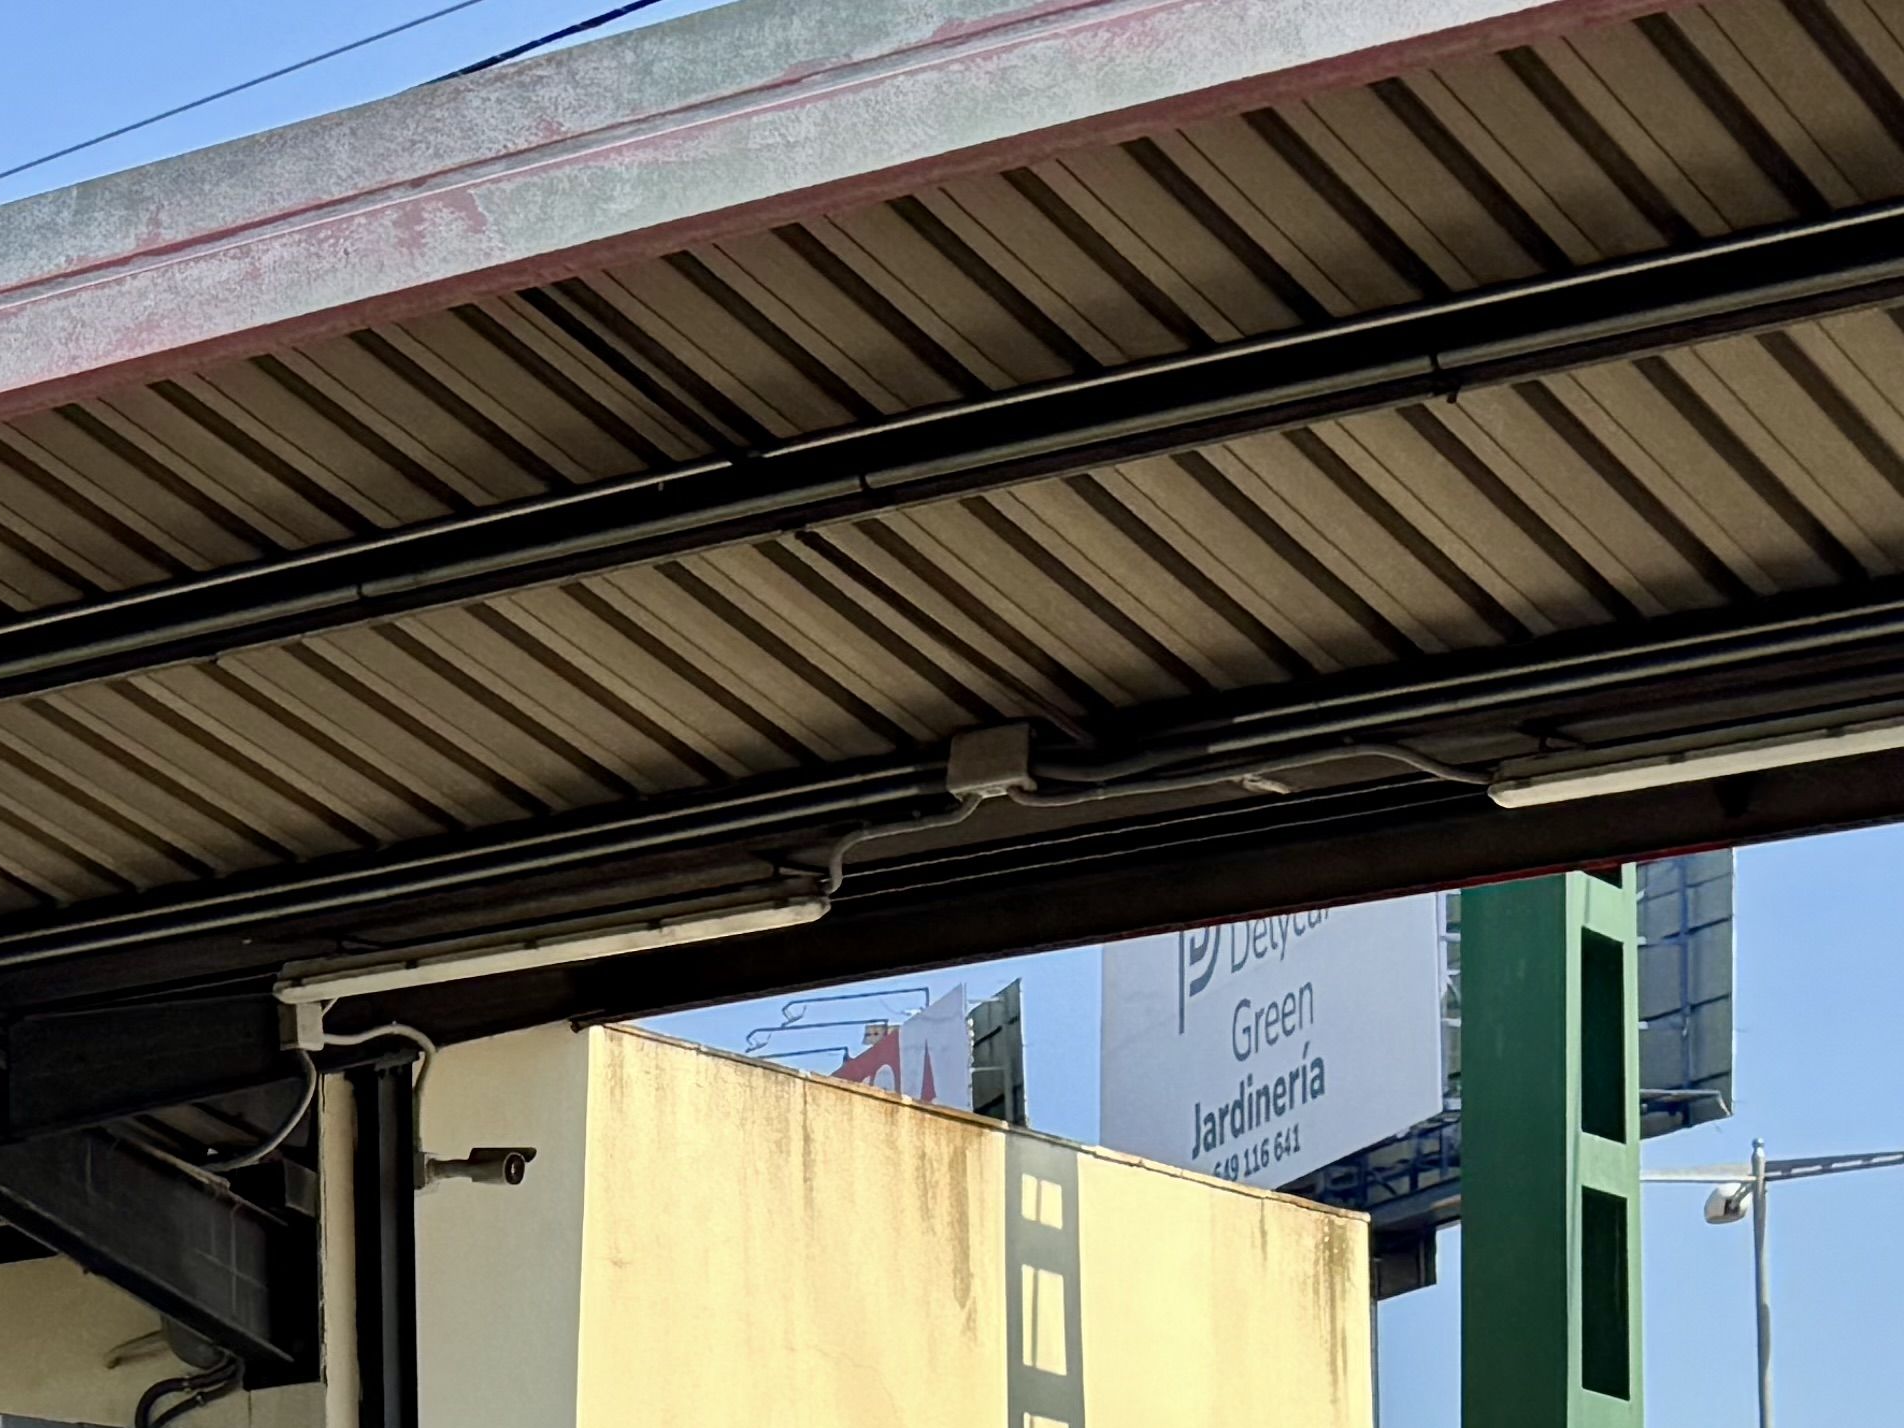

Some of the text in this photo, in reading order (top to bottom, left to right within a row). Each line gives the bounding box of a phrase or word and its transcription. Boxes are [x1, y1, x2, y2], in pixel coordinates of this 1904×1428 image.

[1232, 981, 1314, 1062] Green
[1191, 1040, 1325, 1161] Jardinería
[1243, 1137, 1270, 1178] 116
[1273, 1122, 1301, 1162] 641
